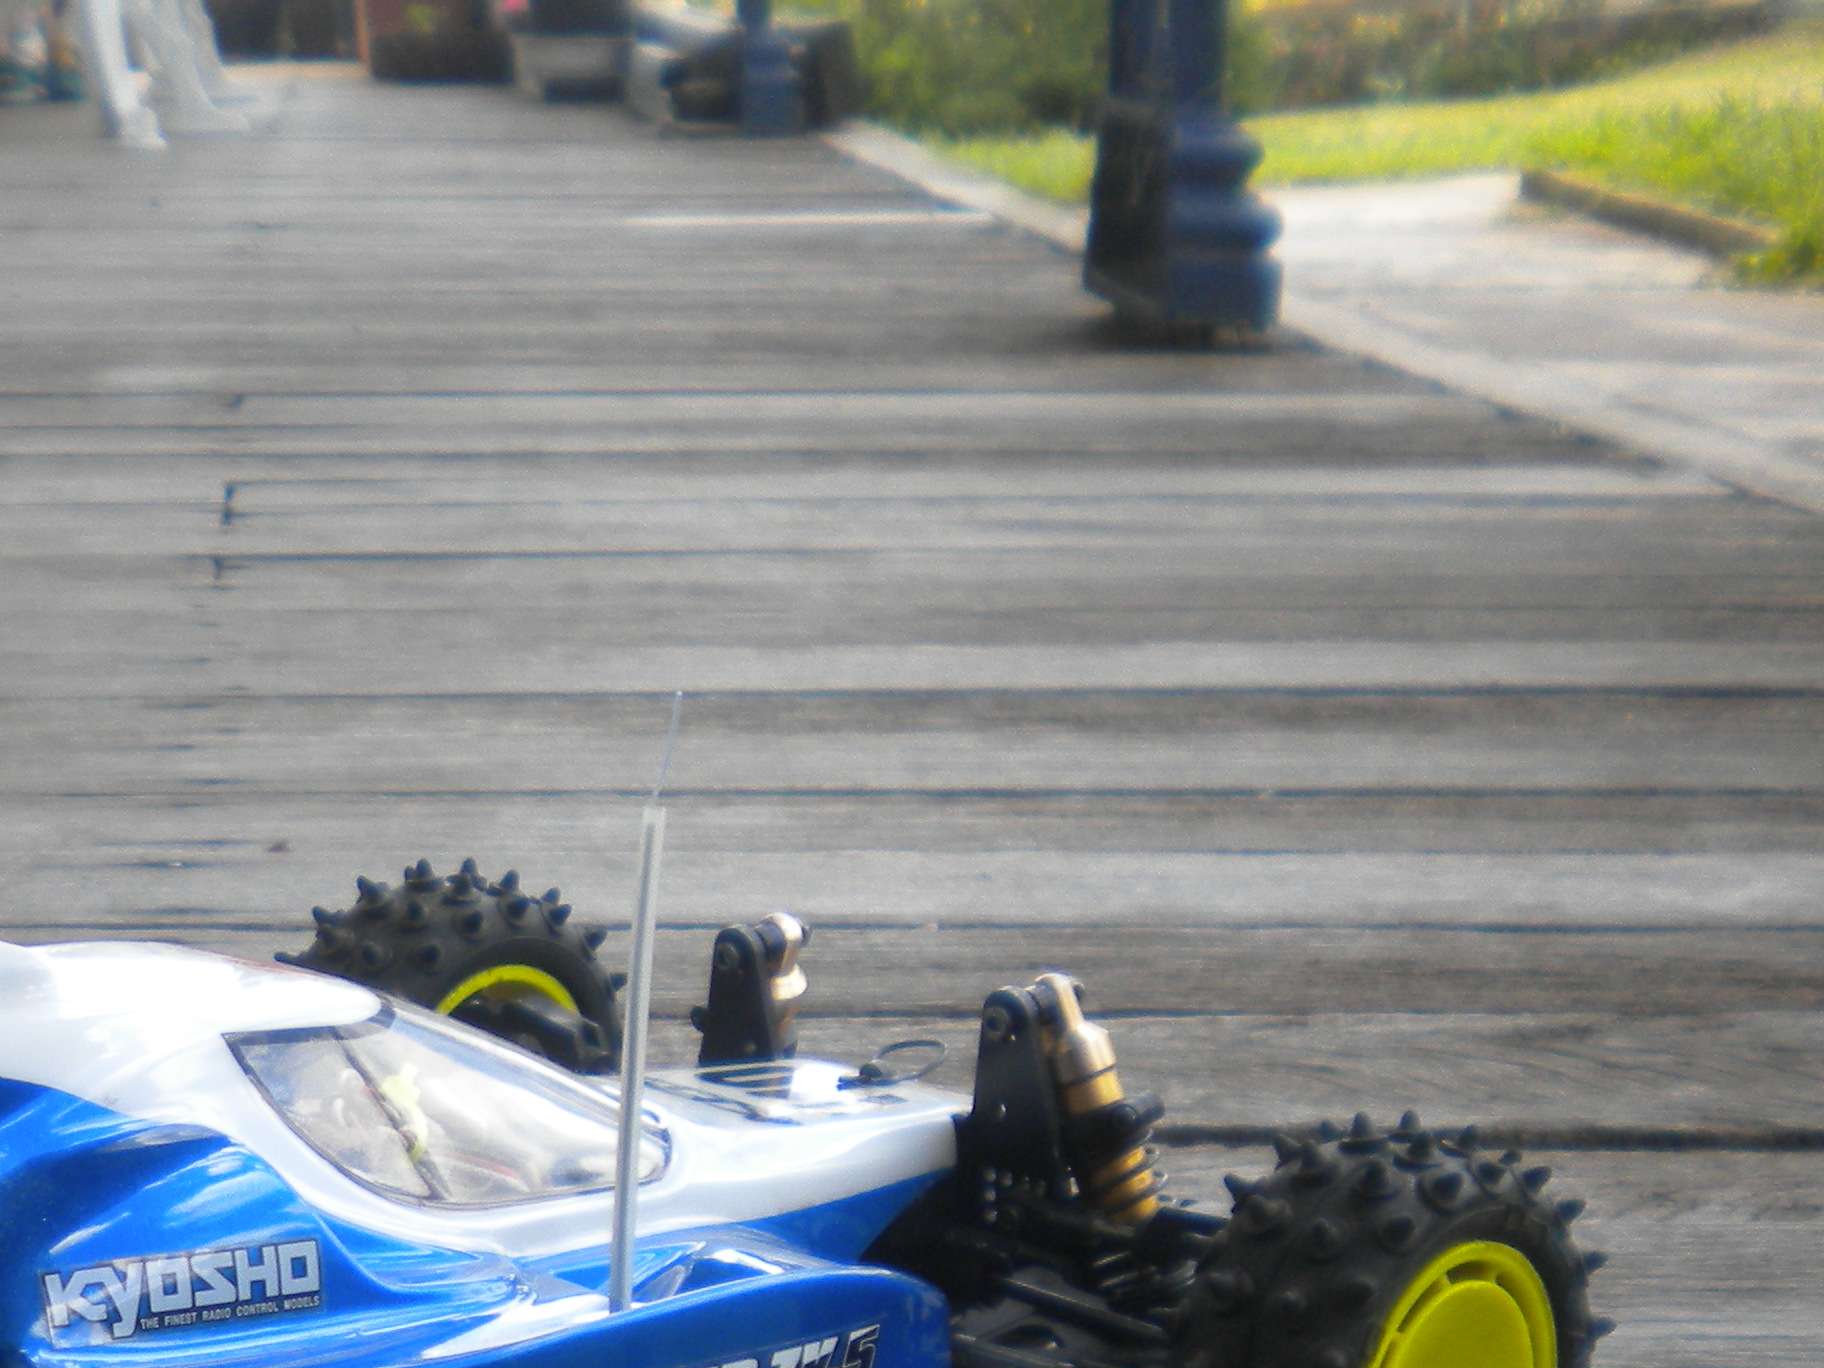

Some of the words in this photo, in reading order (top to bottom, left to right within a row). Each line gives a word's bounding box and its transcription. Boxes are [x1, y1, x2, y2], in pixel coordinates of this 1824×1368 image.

[140, 1316, 160, 1330] THE
[164, 1312, 197, 1327] FINEST
[202, 1306, 232, 1321] RADIO
[236, 1301, 279, 1317] CONTROL
[284, 1295, 320, 1310] MODELS
